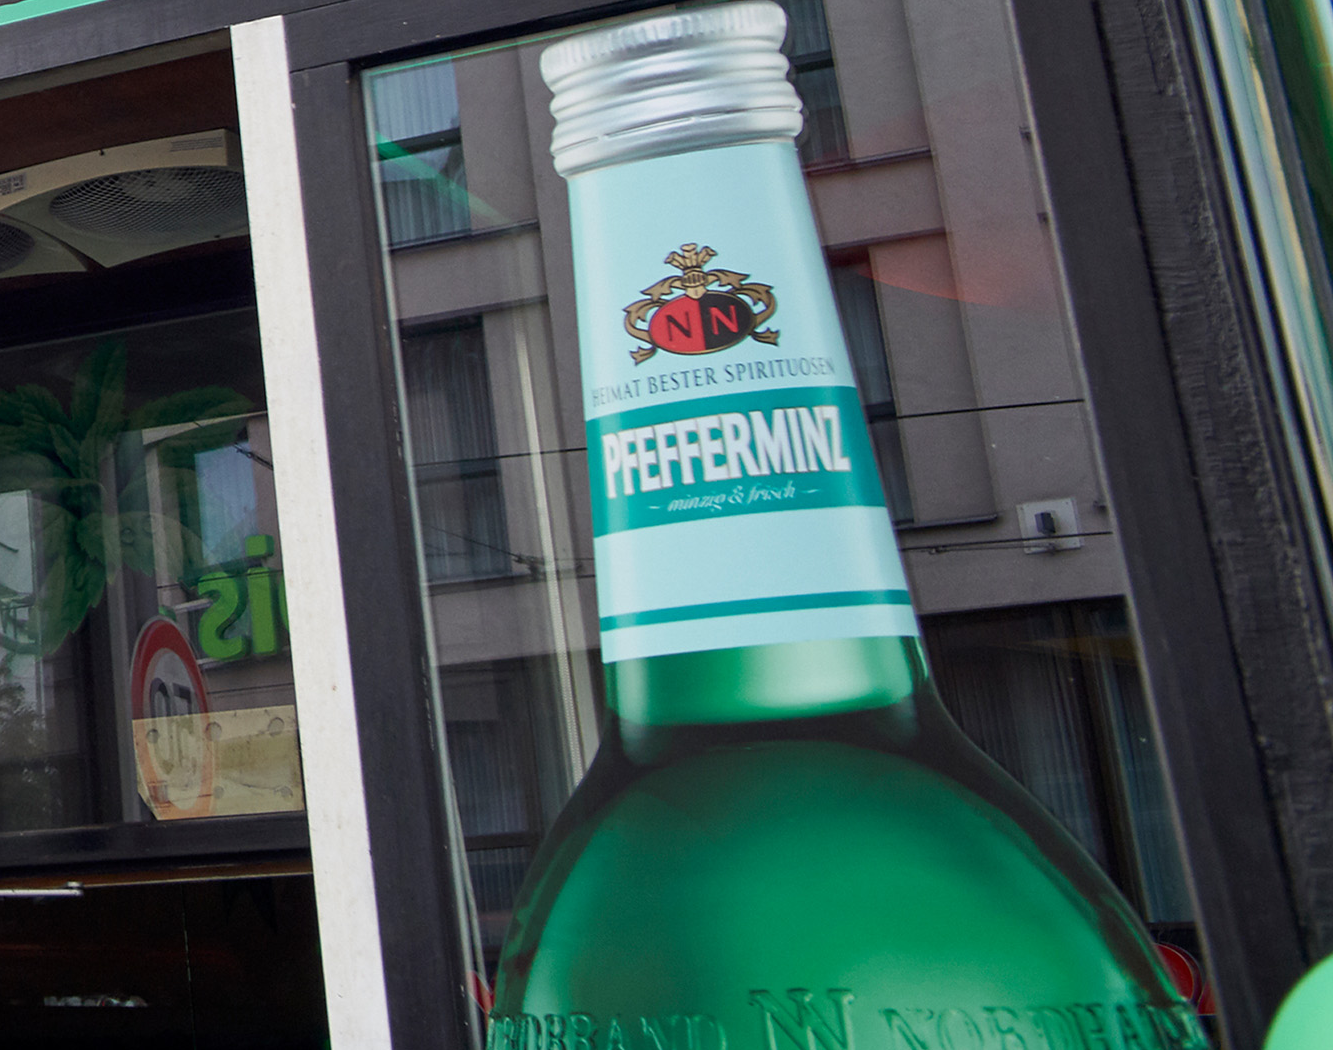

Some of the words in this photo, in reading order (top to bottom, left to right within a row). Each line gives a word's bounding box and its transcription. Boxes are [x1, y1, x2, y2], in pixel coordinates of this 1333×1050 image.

[591, 379, 642, 407] HEIMAT
[647, 367, 718, 395] BESTER
[724, 356, 836, 383] SPIRITUOSEN
[601, 404, 852, 500] PFEFFERMINZ
